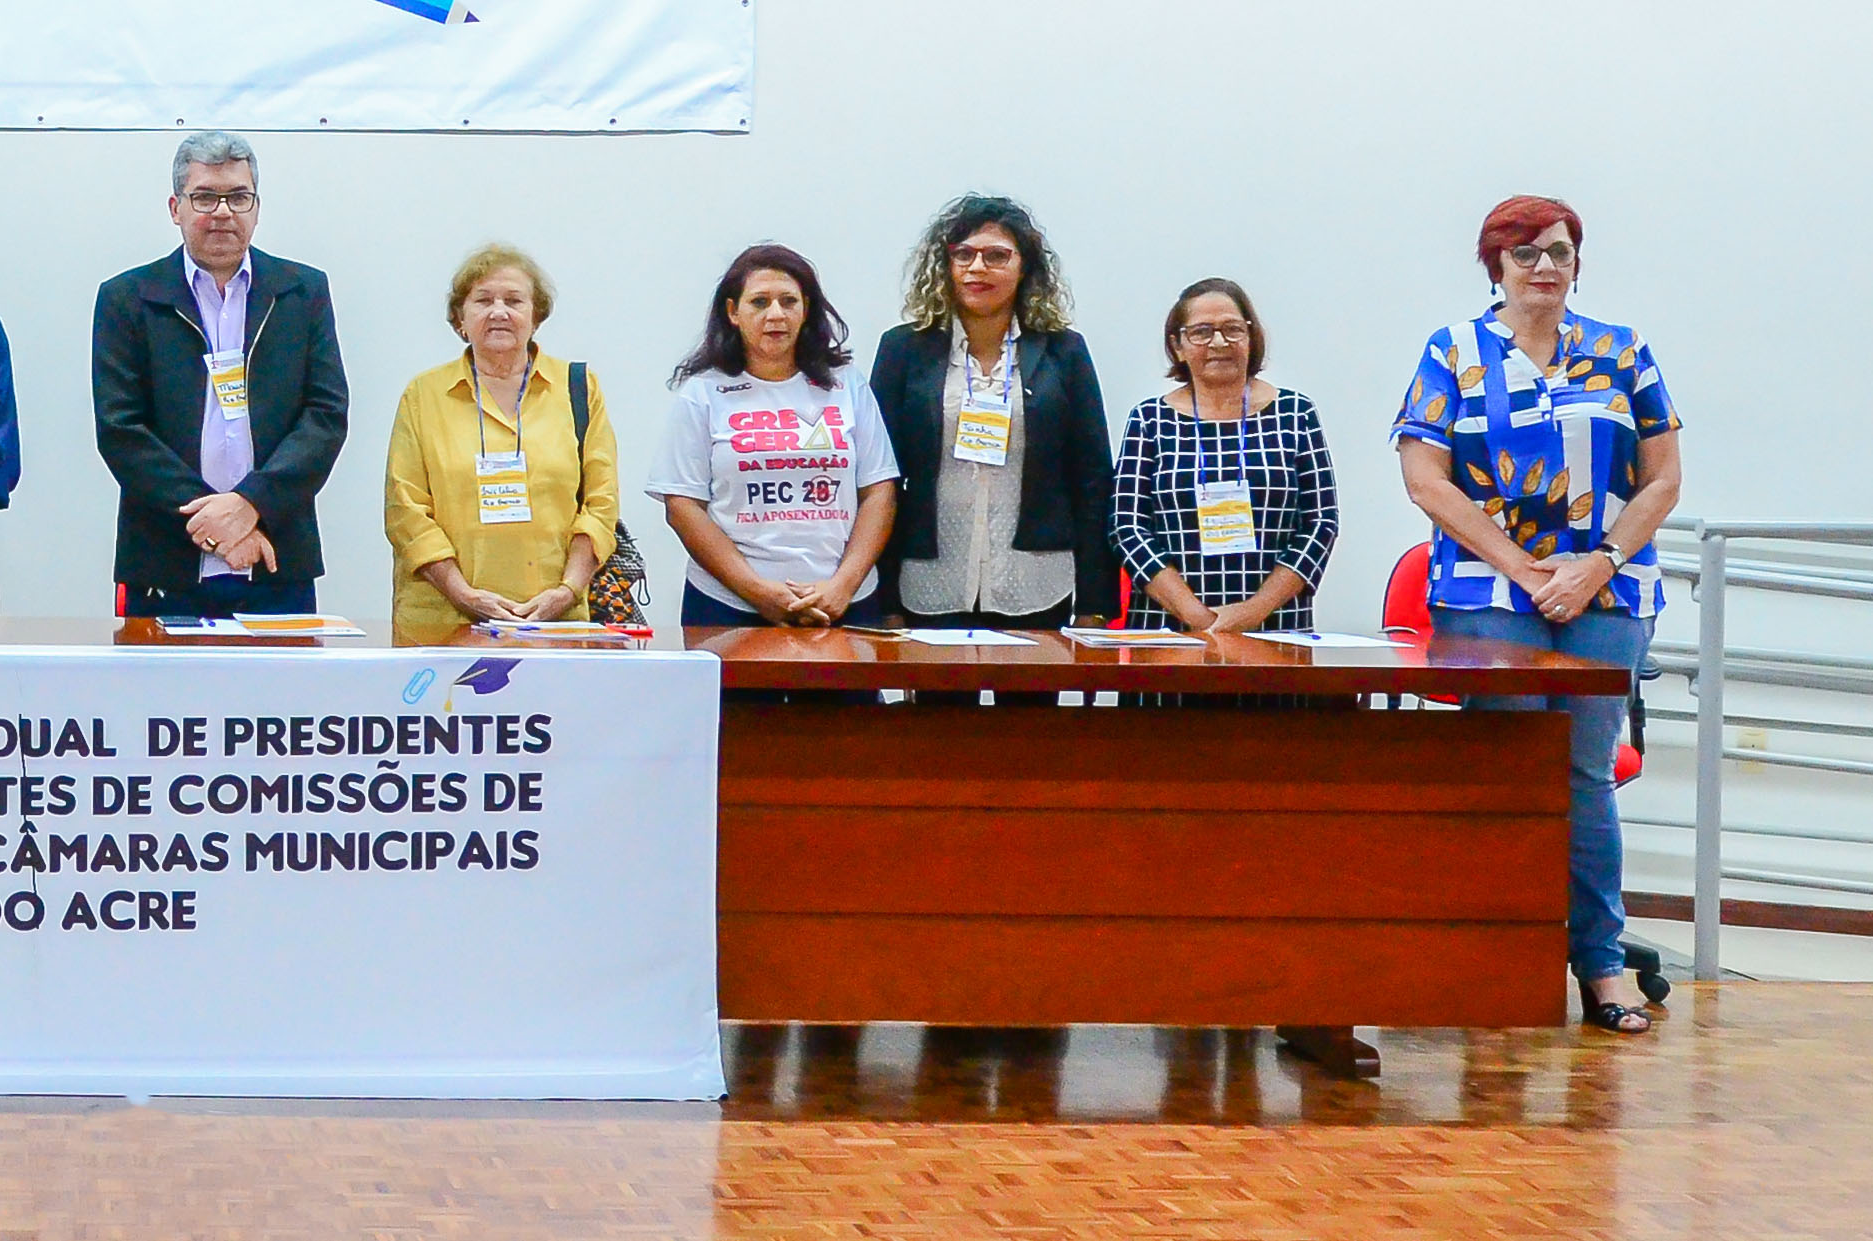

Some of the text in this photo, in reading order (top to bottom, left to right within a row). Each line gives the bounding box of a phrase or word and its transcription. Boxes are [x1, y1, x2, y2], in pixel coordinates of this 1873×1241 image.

[729, 406, 844, 430] GREVE
[730, 422, 849, 453] GERAL
[738, 454, 849, 471] DA EDUCAÇÃO
[747, 480, 841, 504] PEC 287
[148, 717, 208, 757] DE
[224, 714, 552, 756] PRESIDENTES
[92, 775, 152, 816] DE
[168, 761, 468, 815] COMISSÕES
[483, 772, 543, 812] DE
[245, 830, 539, 872] MUNICIPAIS
[61, 890, 197, 931] ACRE
